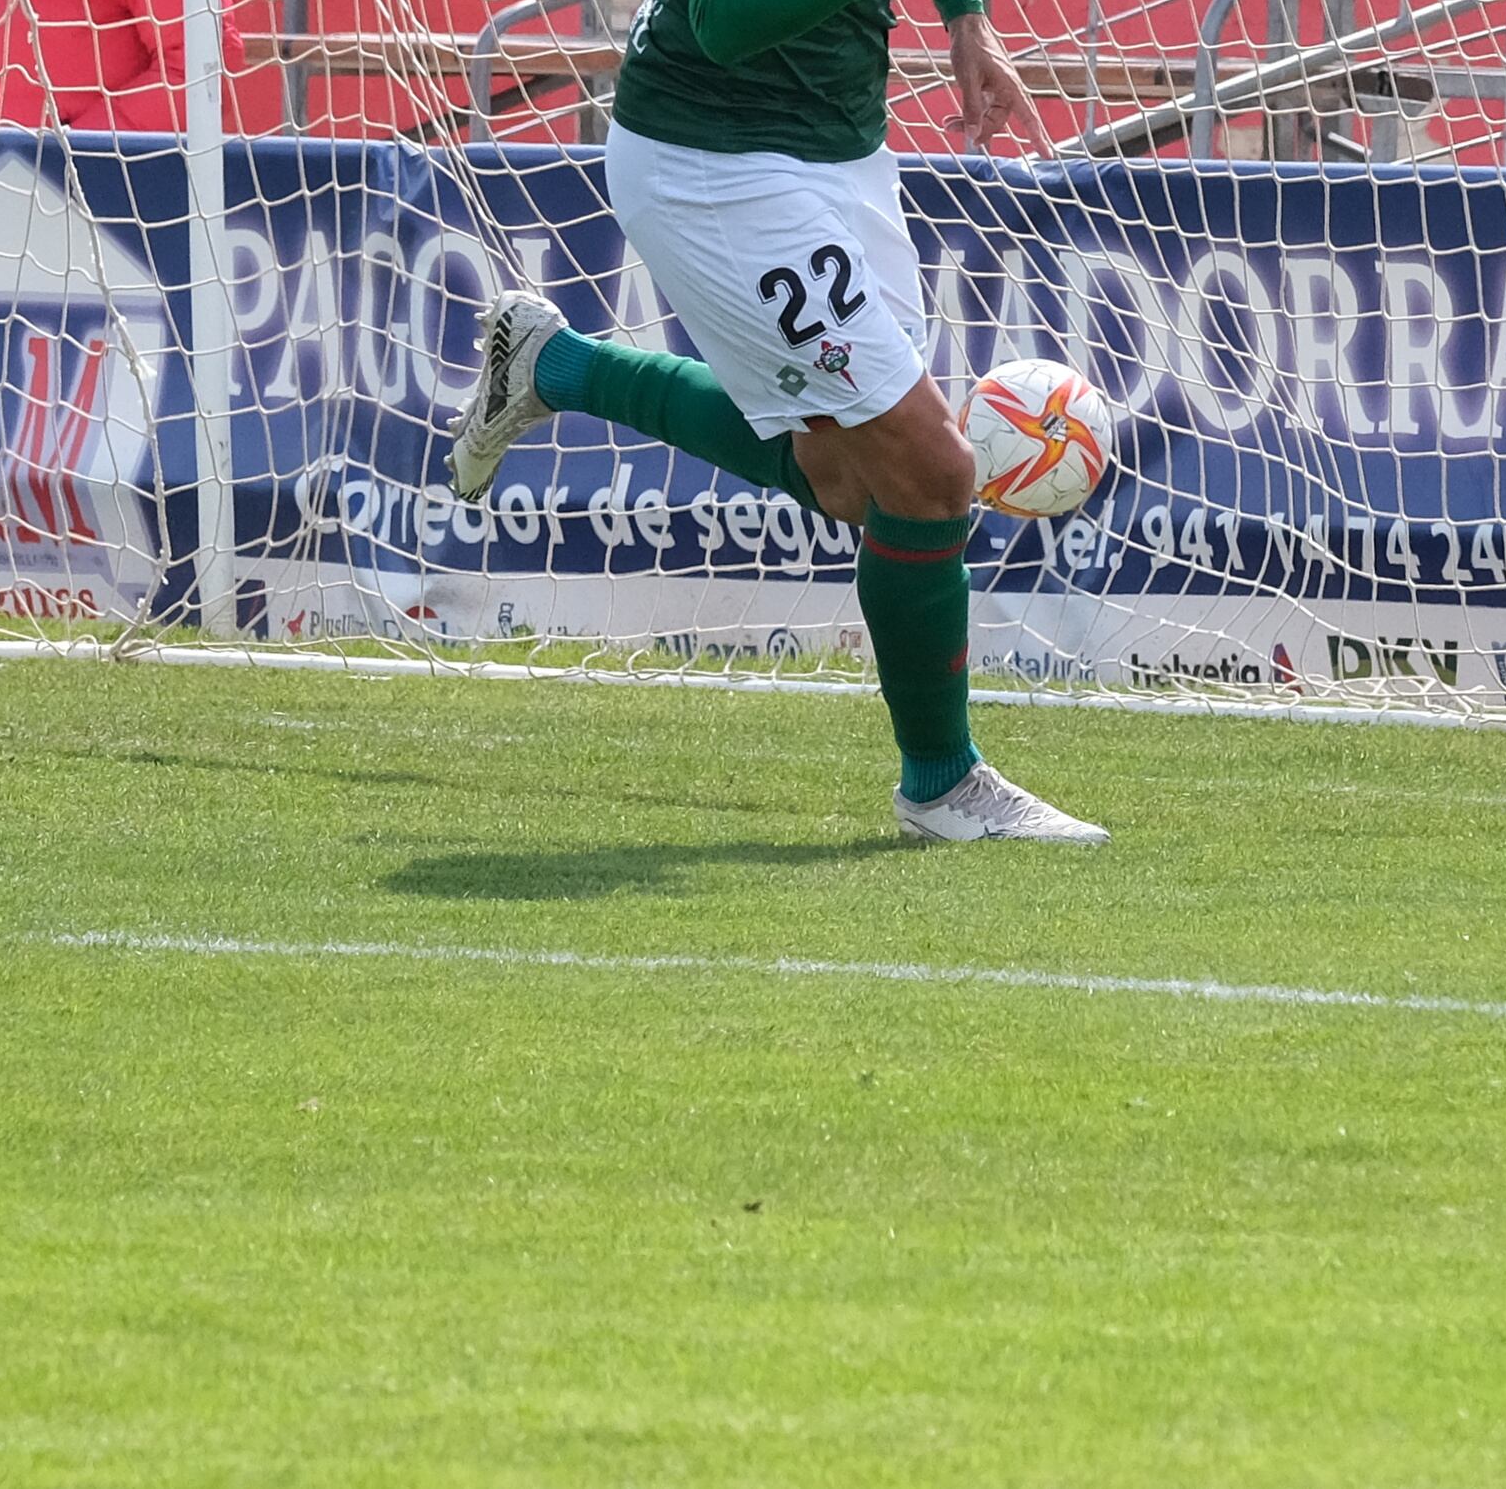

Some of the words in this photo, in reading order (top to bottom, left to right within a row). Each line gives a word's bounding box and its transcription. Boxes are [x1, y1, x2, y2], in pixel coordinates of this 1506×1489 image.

[757, 244, 866, 350] 22
[588, 463, 676, 550] de
[692, 492, 863, 575] segu
